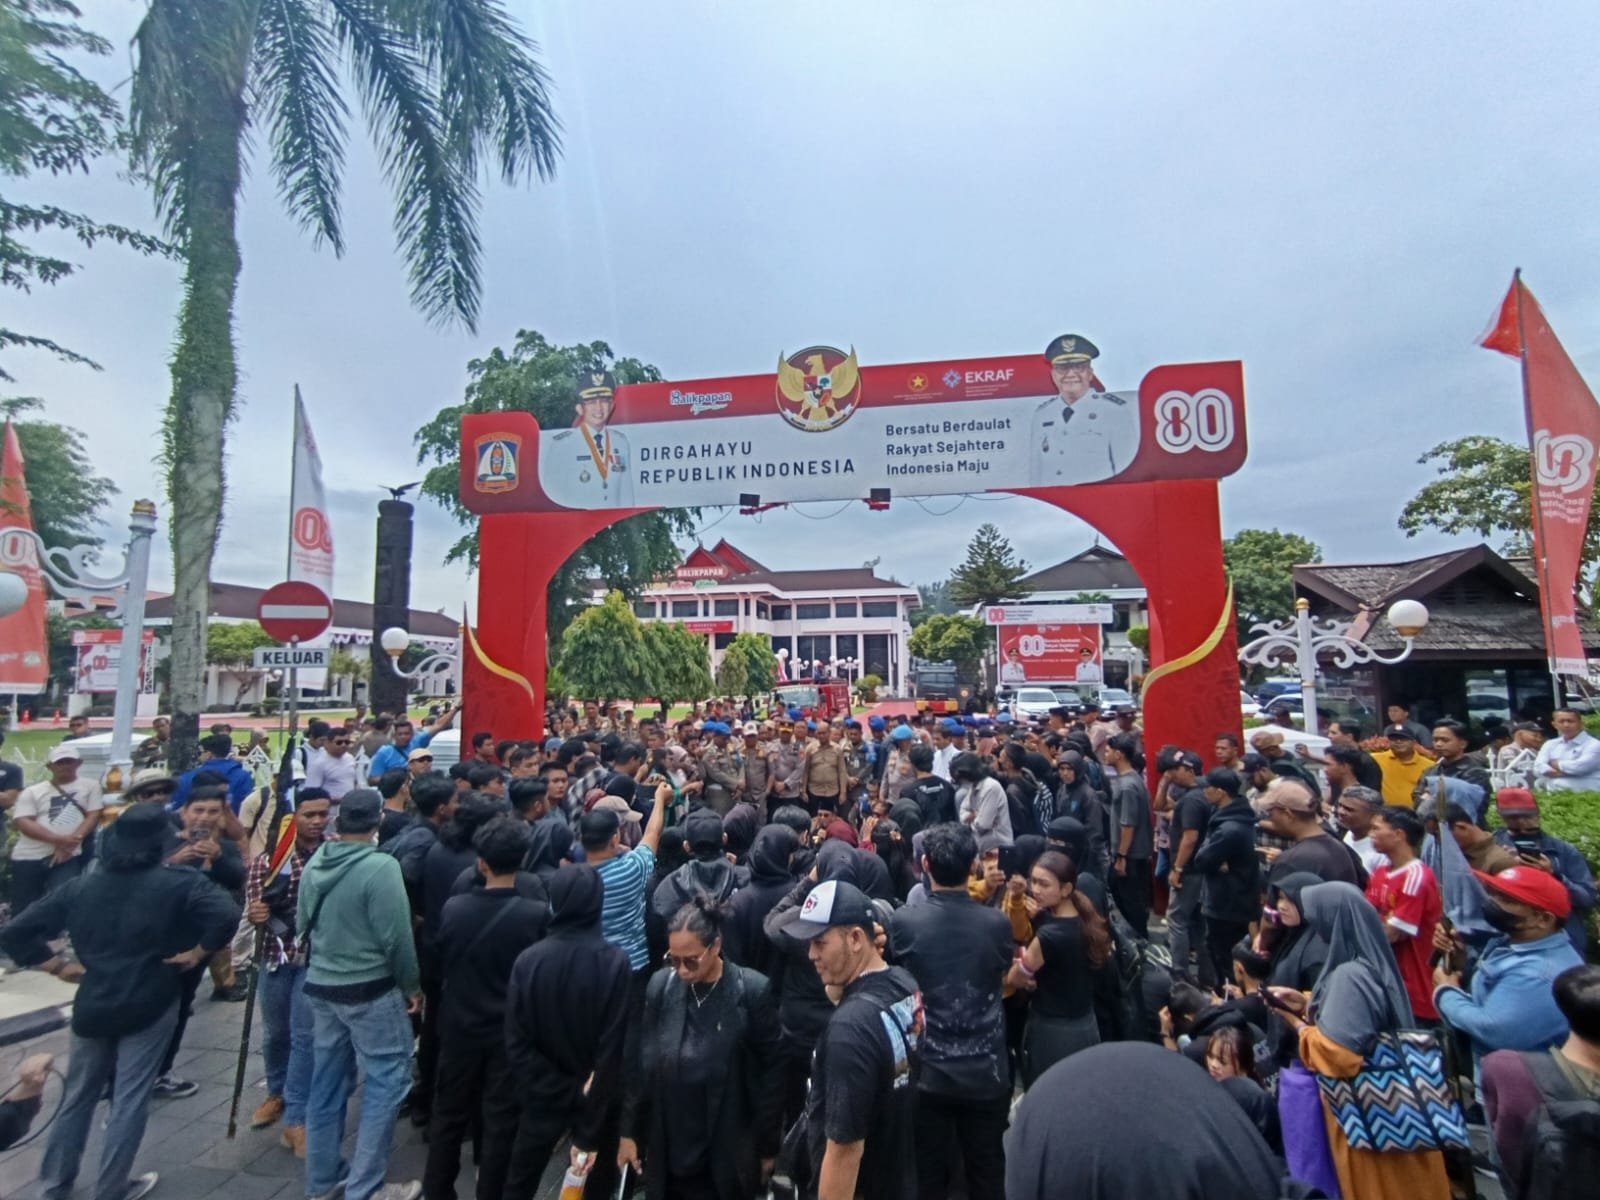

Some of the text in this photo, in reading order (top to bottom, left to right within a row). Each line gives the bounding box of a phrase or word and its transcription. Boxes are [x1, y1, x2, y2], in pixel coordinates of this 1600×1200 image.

[964, 369, 1014, 383] EKRAF
[670, 390, 732, 405] Balikpapan
[886, 418, 1011, 435] Bersatu Berdaulat
[1154, 388, 1234, 453] 80
[640, 441, 752, 461] DIRGAHAYU
[886, 440, 1005, 456] Rakyat Sejahtera
[640, 458, 855, 484] REPUBLIK INDONESIA
[886, 459, 989, 474] Indonesia Maju
[262, 651, 323, 664] KELUAR
